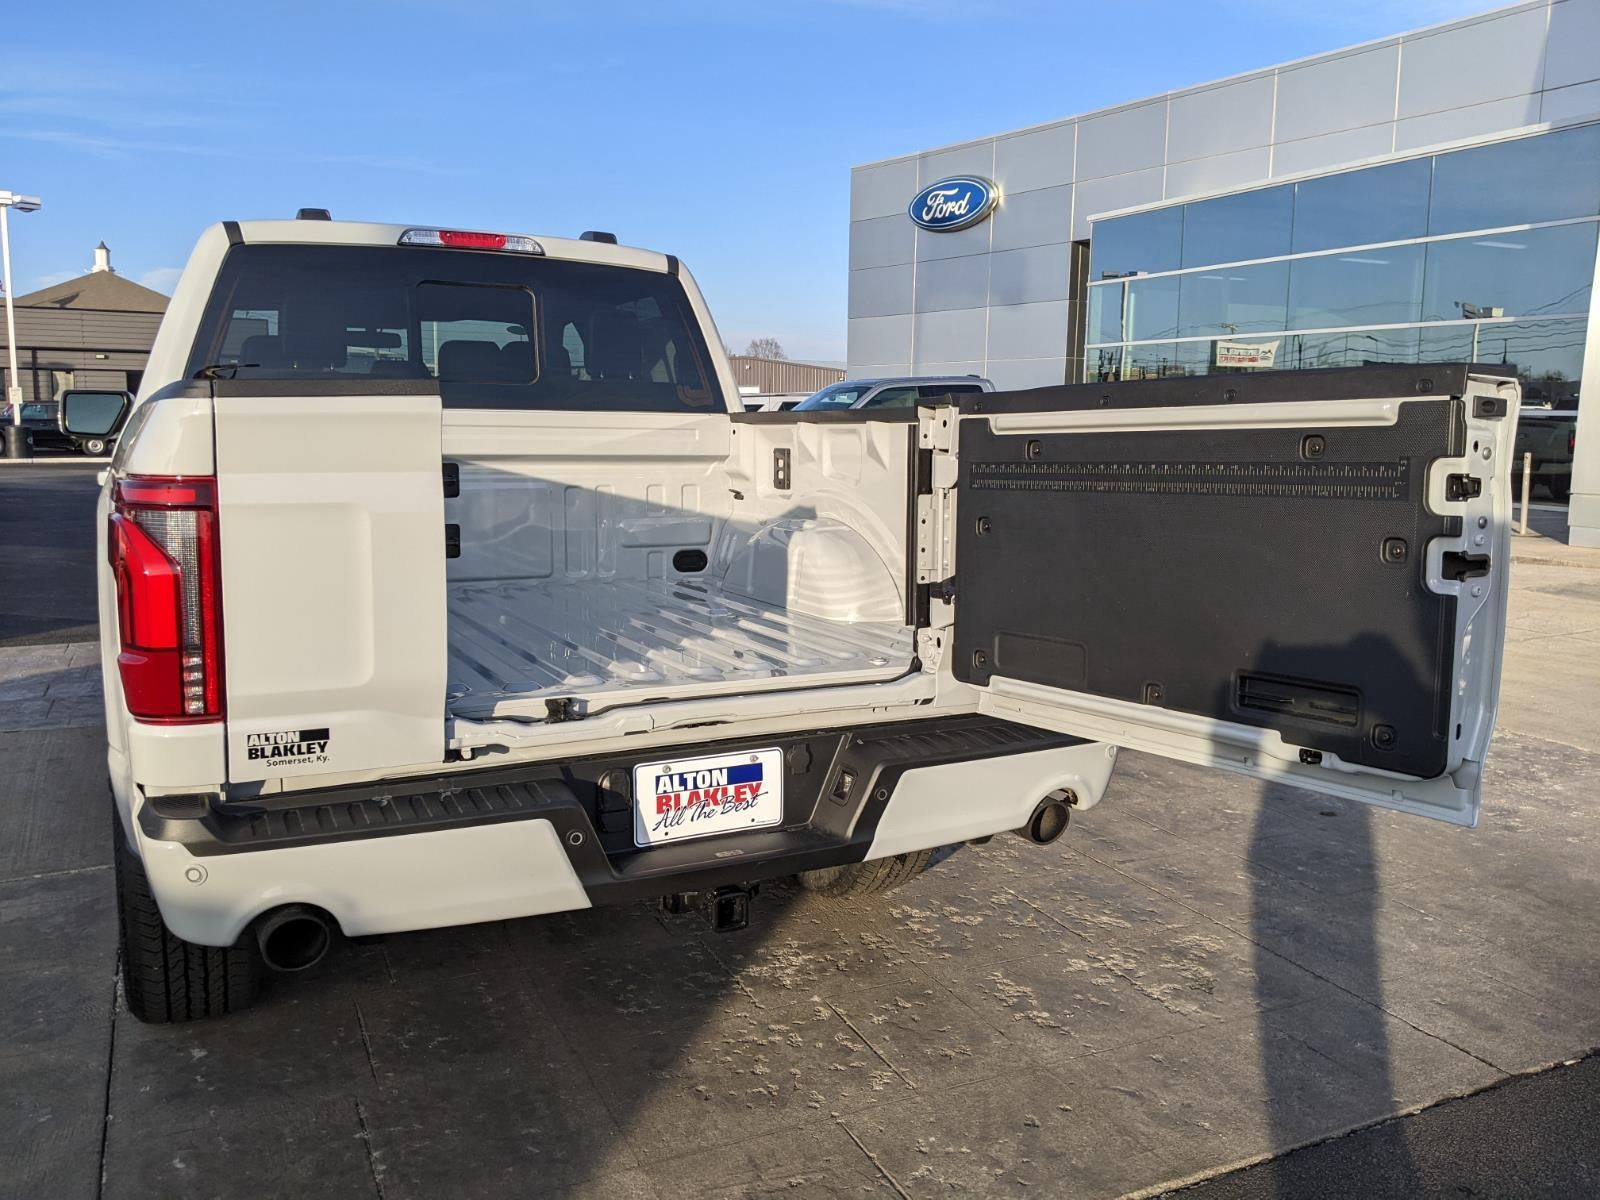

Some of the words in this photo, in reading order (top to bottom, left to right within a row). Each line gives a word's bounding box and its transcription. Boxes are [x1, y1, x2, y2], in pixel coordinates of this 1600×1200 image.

[922, 188, 972, 221] Ford
[248, 731, 300, 747] ALTON
[248, 741, 328, 760] BLAKLEY
[266, 756, 314, 767] Somerset,
[316, 755, 330, 763] Ky.
[656, 768, 728, 795] ALTON
[652, 805, 687, 831] All
[689, 798, 718, 822] The
[720, 791, 769, 815] Best
[656, 782, 762, 814] BLAKLEY
